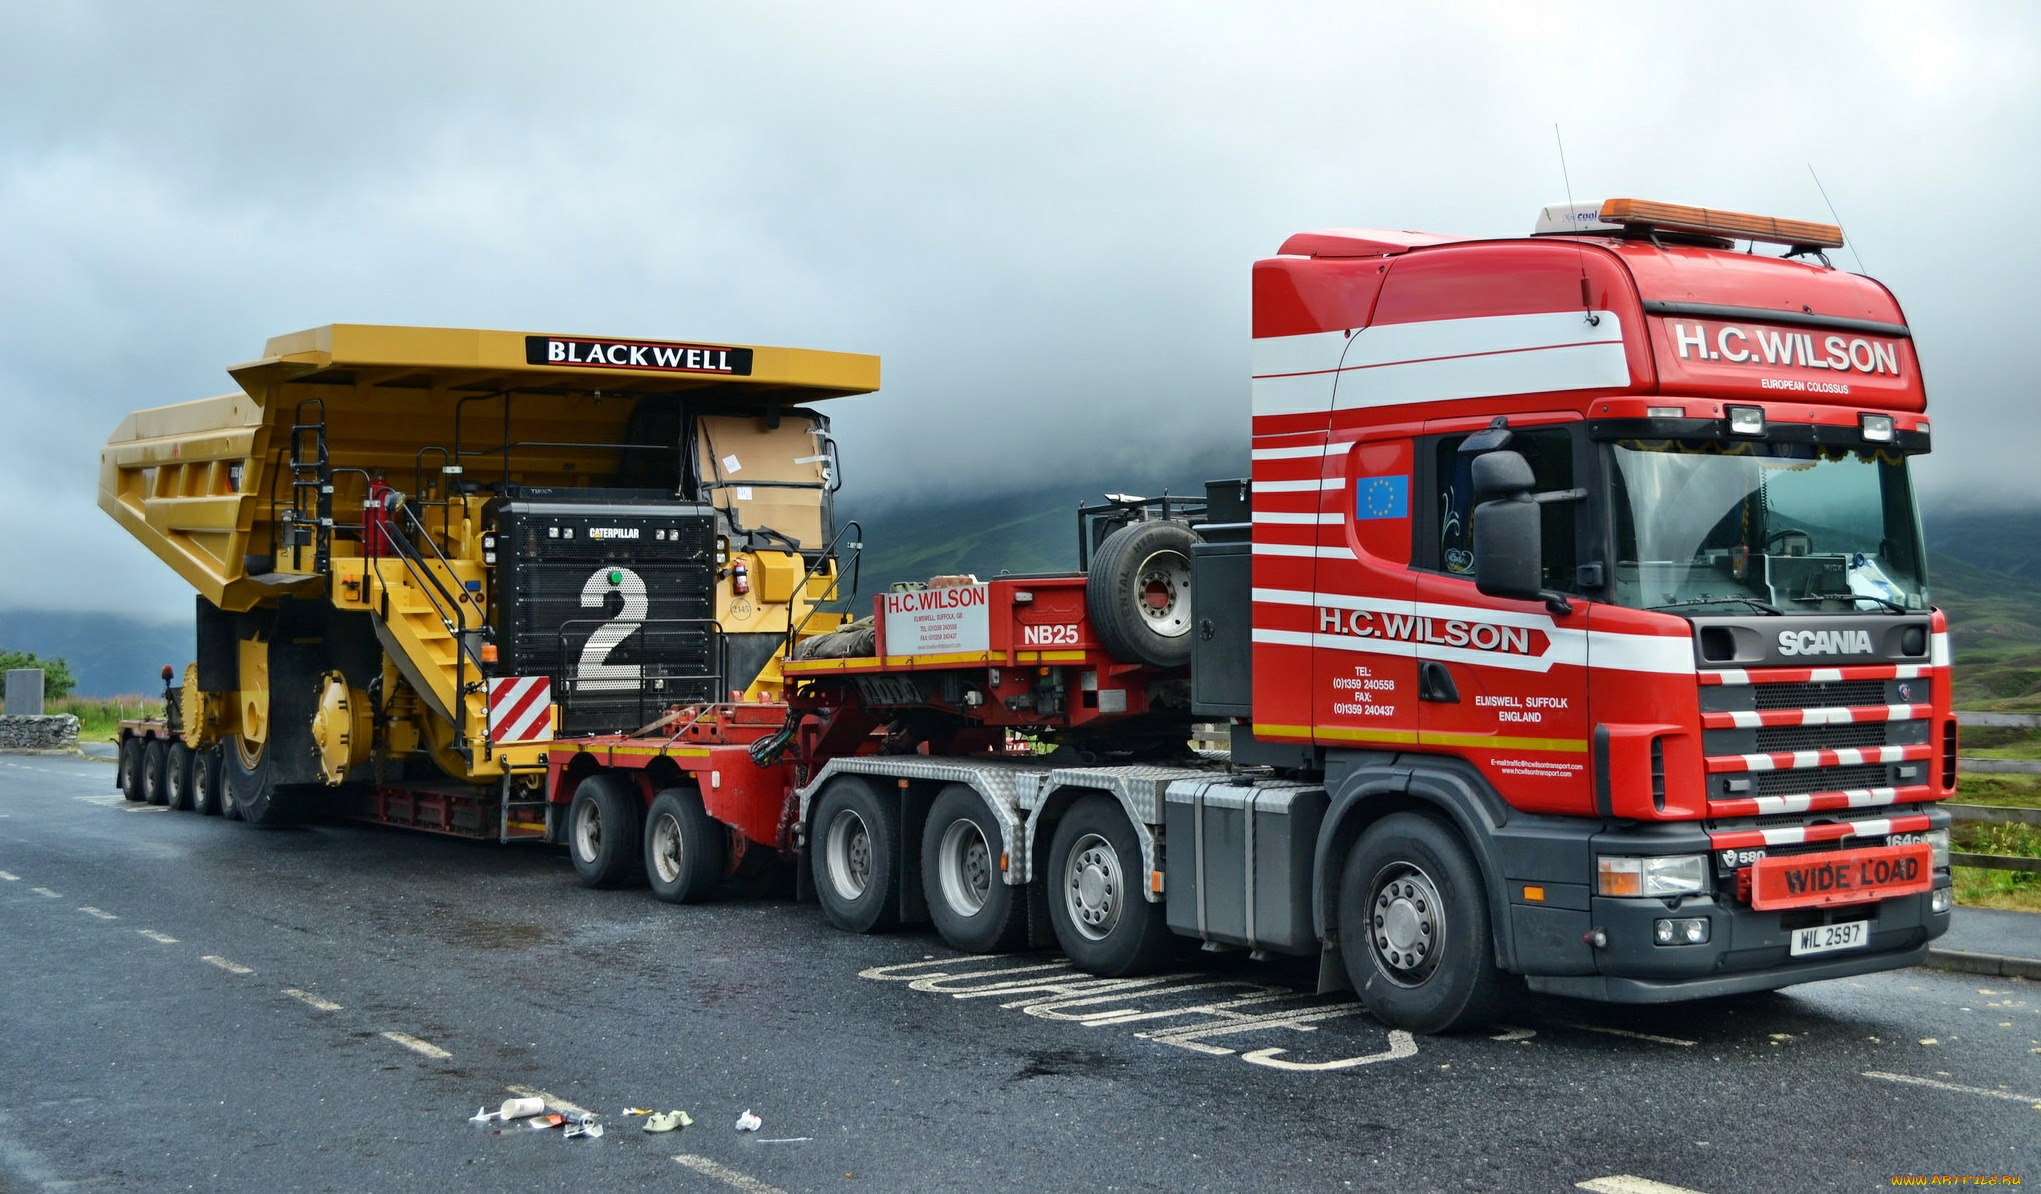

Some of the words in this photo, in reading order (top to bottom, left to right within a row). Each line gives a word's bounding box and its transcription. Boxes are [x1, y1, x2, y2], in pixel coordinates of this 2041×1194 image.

[548, 341, 732, 371] BLACKWELL
[1761, 378, 1805, 391] EUROPEAN
[1806, 381, 1849, 394] COLOSSUS
[589, 527, 640, 540] CATERPILLAR
[732, 605, 750, 614] 2145
[576, 566, 648, 691] 2
[1024, 624, 1079, 645] NB25
[1778, 630, 1873, 656] SCANIA
[1355, 666, 1371, 677] TEL:
[1333, 677, 1361, 689] (0)1359
[1364, 679, 1395, 690] 240558
[1355, 691, 1372, 702] FAX:
[1475, 695, 1523, 708] ELMSWELL,
[1525, 697, 1568, 708] SUFFOLK
[1334, 702, 1362, 714] (0)1359
[1364, 704, 1395, 716] 240437
[1499, 711, 1542, 722] ENGLAND
[1739, 850, 1766, 864] 580
[1785, 864, 1850, 893] WIDE
[1861, 857, 1919, 886] LOAD
[1800, 928, 1821, 950] WIL
[1825, 924, 1860, 945] 2597
